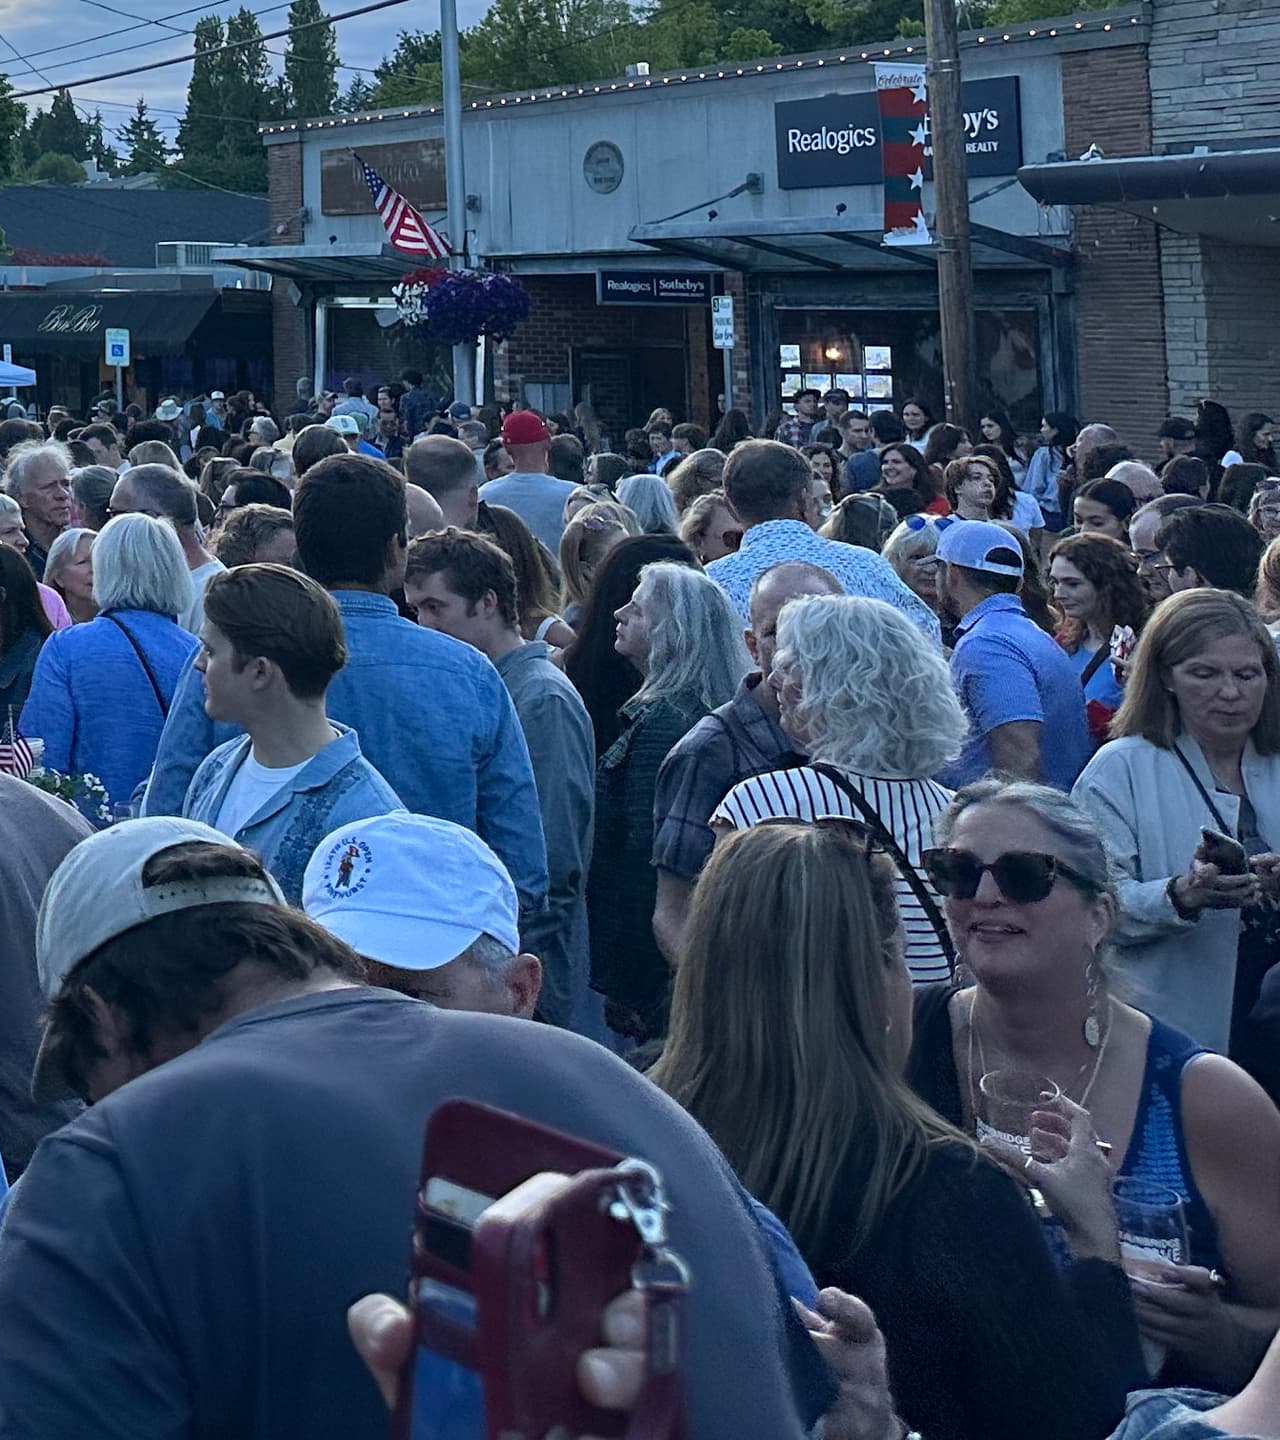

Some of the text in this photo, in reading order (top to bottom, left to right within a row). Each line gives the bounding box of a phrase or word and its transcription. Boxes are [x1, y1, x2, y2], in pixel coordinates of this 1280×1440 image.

[787, 123, 877, 155] Realogics
[965, 141, 999, 154] REALTY
[607, 279, 705, 293] Realogics Sotheby's
